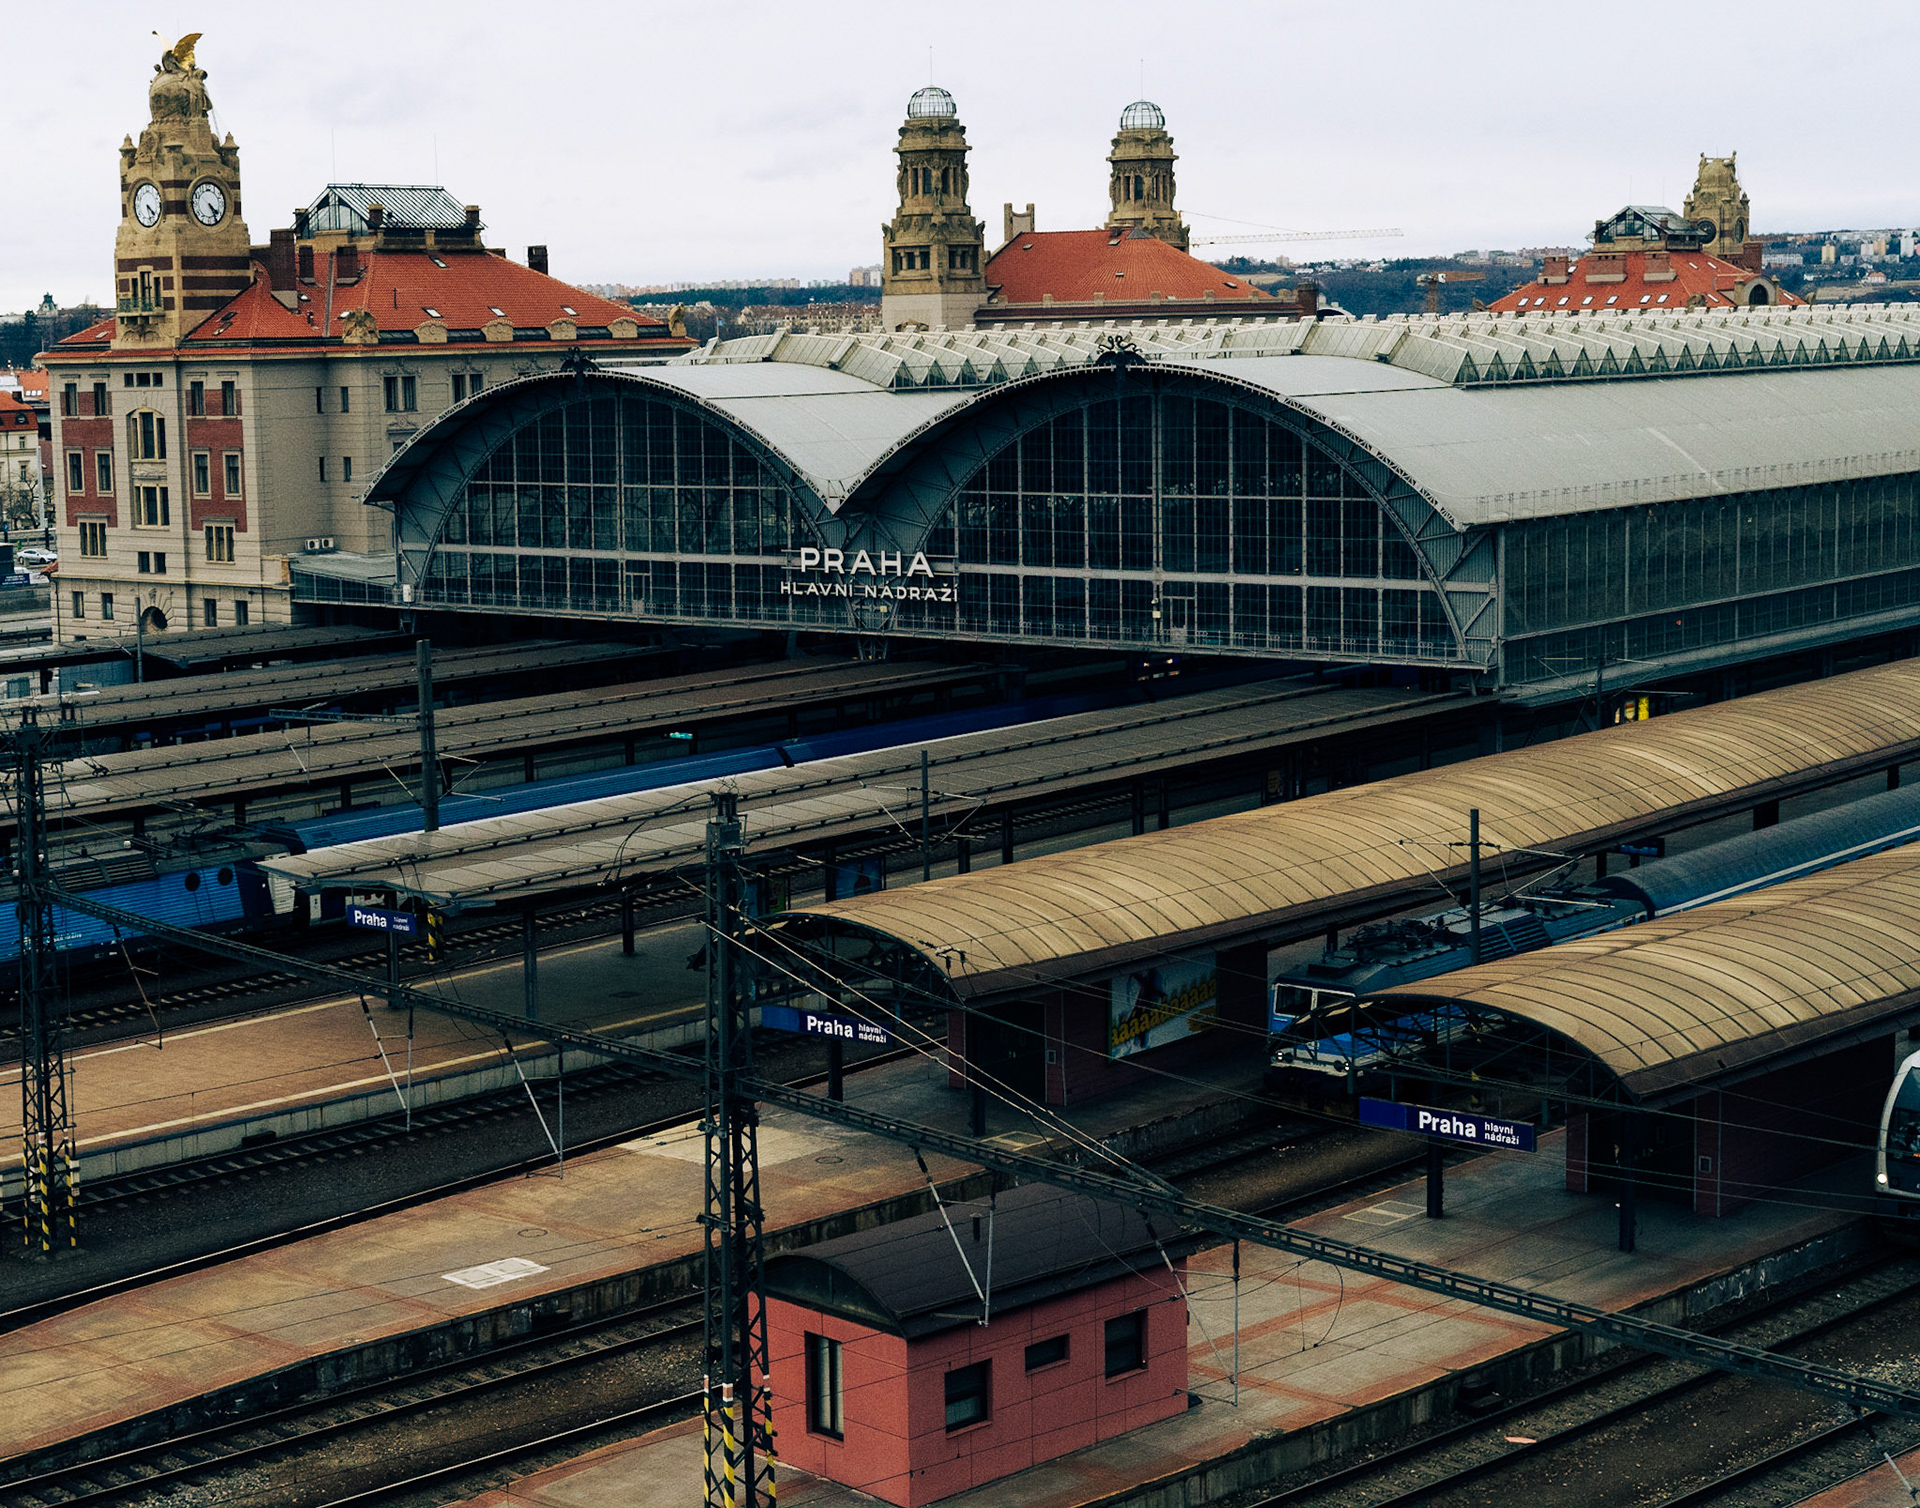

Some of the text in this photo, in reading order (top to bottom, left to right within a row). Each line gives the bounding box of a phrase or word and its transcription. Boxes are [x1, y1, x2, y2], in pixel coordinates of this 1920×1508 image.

[800, 546, 934, 578] PRAHA
[780, 577, 958, 602] HLAVNÍ NÁDRAŽÍ
[354, 909, 387, 928] Praha
[806, 1015, 853, 1038] Praha
[858, 1023, 882, 1035] hlavní
[858, 1032, 887, 1044] nádraží
[1418, 1110, 1477, 1138] Praha
[1484, 1121, 1514, 1135] hlavní
[1484, 1131, 1520, 1146] nádraží
